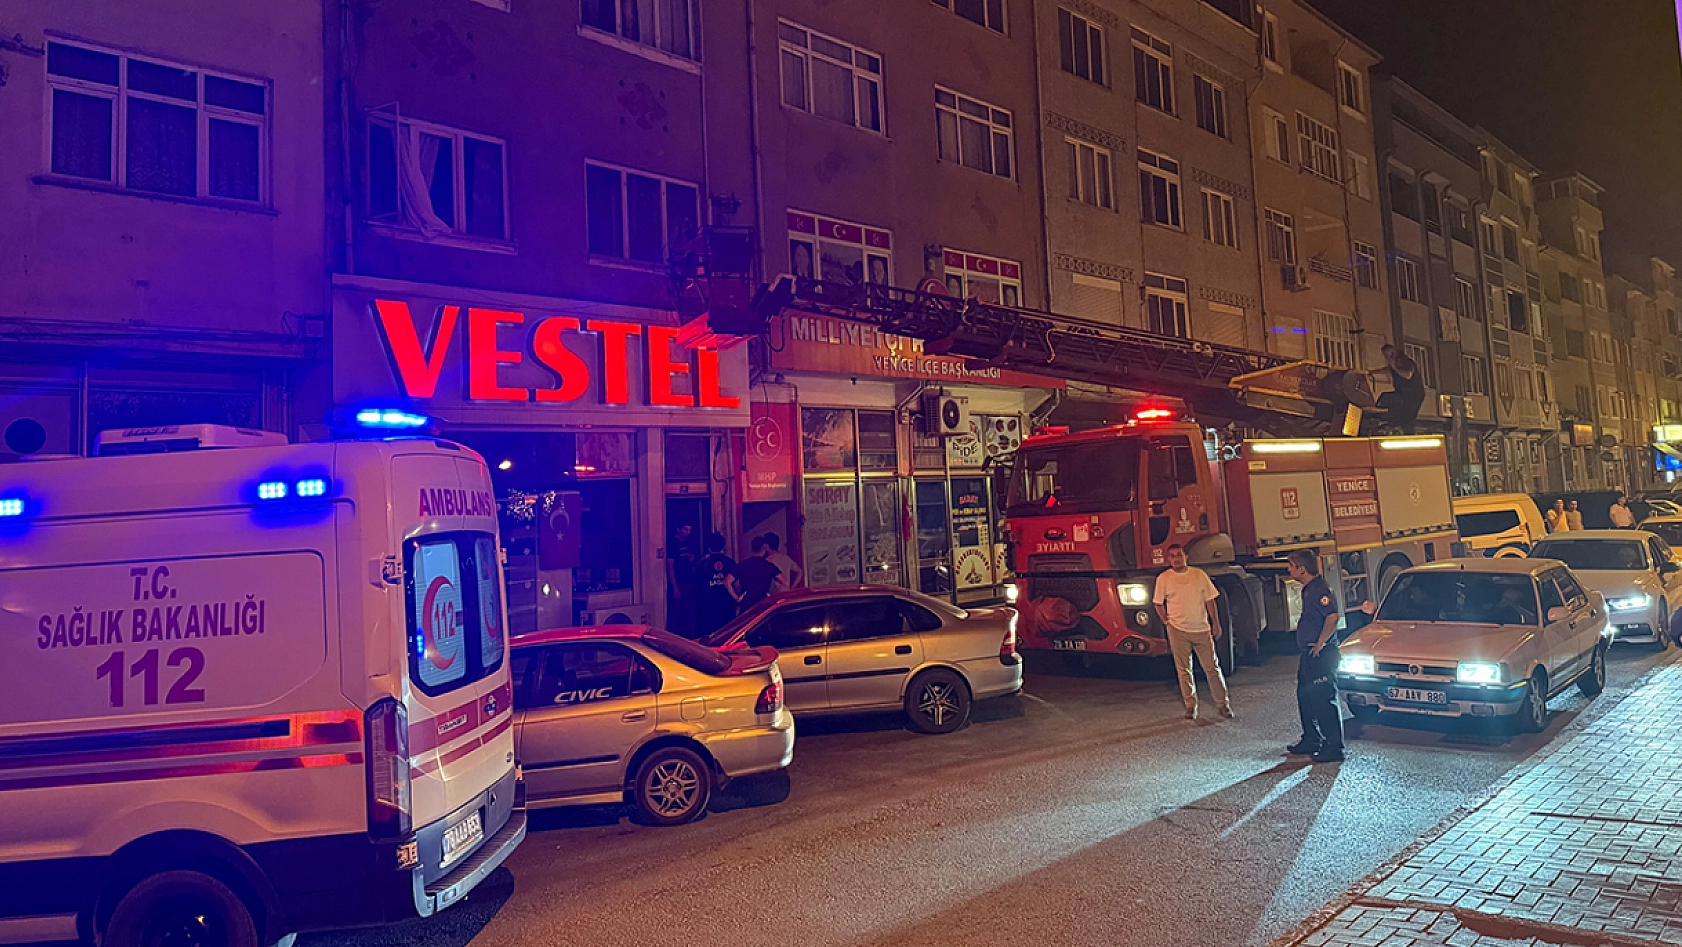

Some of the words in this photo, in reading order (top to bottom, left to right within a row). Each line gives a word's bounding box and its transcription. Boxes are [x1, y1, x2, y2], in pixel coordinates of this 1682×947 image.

[375, 298, 740, 409] VESTEL
[873, 354, 915, 373] YENİCE
[757, 471, 777, 481] MHP
[419, 488, 491, 517] AMBULANS
[809, 487, 849, 505] SARAY
[1282, 491, 1296, 506] 112
[129, 564, 177, 601] T.C.
[37, 605, 124, 650] SAĞLIK
[131, 593, 265, 642] BAKANLIĞI
[434, 600, 456, 641] 112
[96, 646, 206, 708] 112
[554, 686, 613, 705] CIVIC
